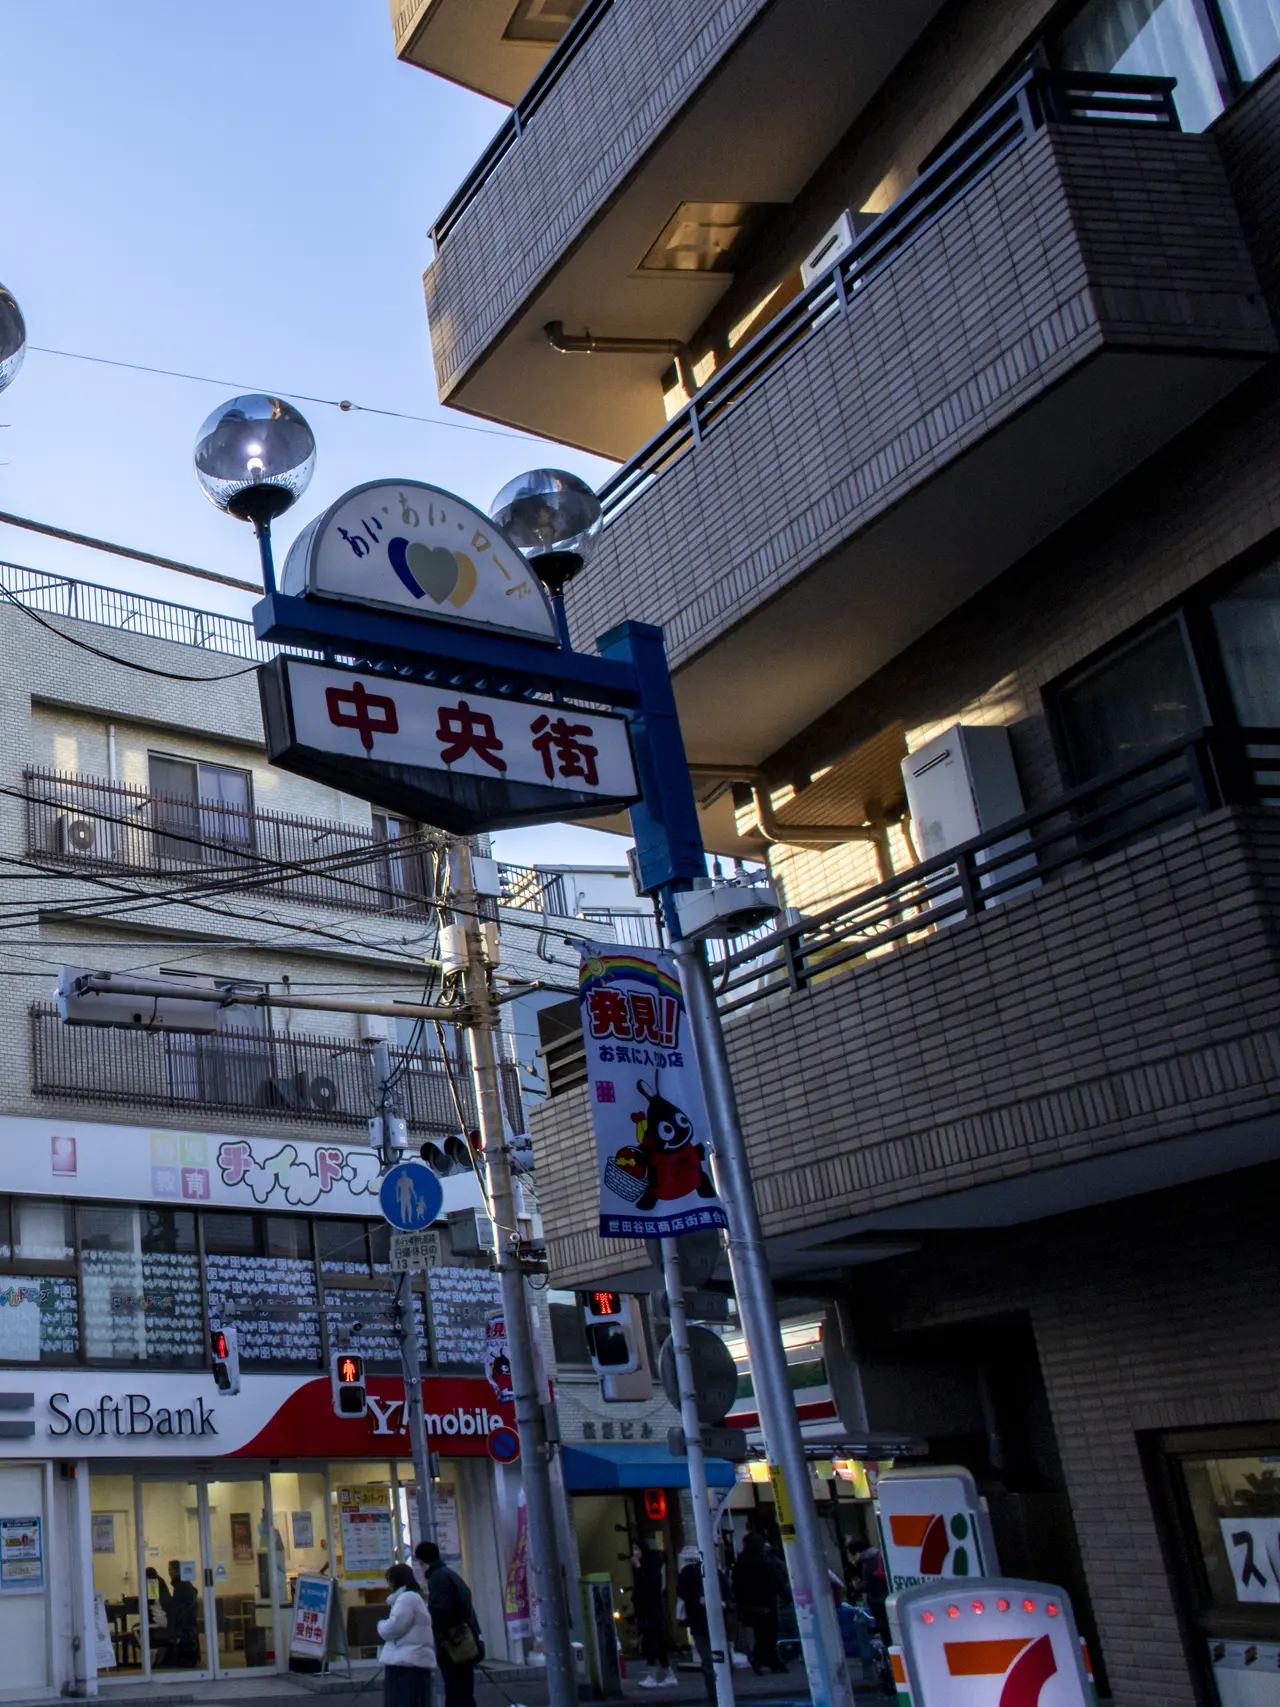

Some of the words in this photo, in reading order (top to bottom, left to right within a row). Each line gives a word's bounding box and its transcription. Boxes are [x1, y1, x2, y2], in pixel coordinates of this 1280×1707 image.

[325, 681, 600, 786] 中央街
[609, 1207, 729, 1233] 世田谷区商店街連合
[47, 1392, 219, 1437] SoftBank
